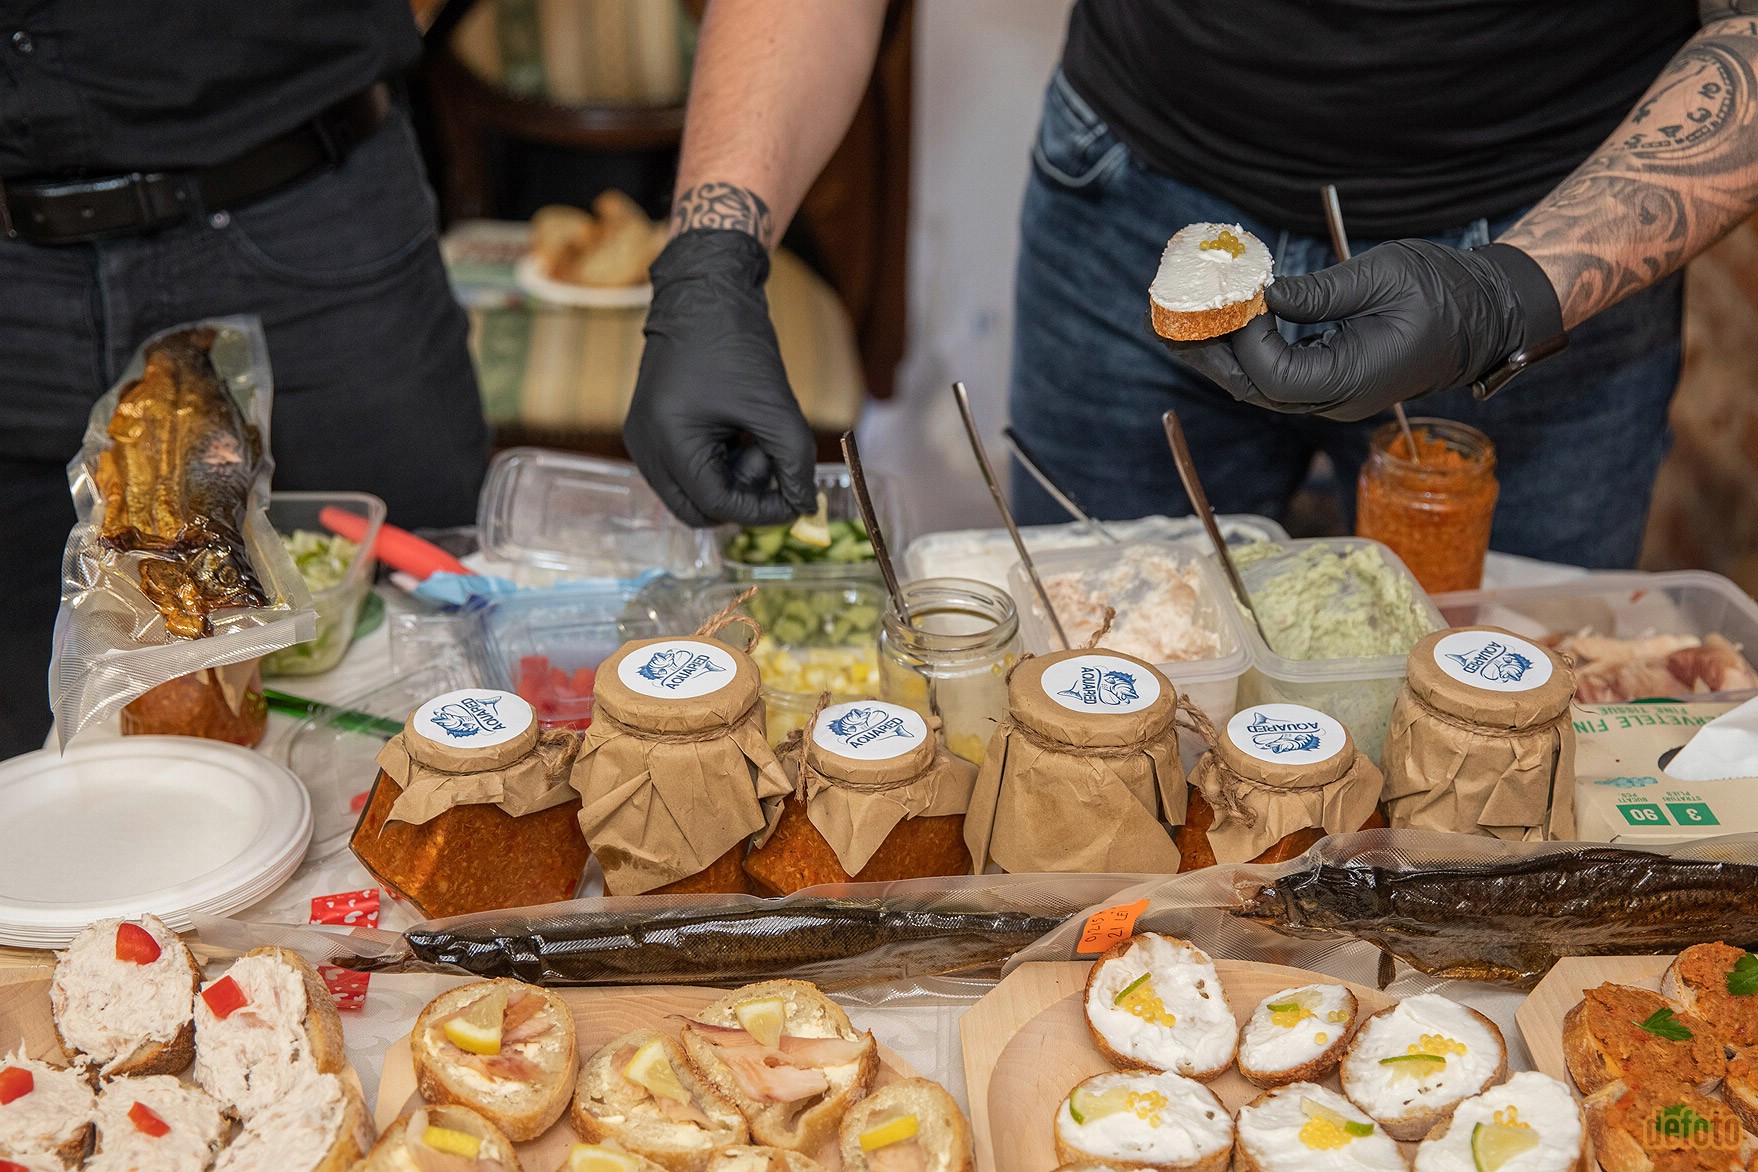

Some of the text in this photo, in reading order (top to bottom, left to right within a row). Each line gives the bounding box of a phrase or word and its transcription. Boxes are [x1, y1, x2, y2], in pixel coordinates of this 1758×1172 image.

[666, 654, 710, 690] AQUARED
[1463, 640, 1502, 674] AQUARED
[1081, 666, 1098, 705] AQUARED
[461, 698, 506, 730] AQUARED
[1600, 706, 1688, 716] FINE TISSUE
[849, 717, 904, 748] AQUARED
[1247, 722, 1319, 733] AQUARED
[1629, 809, 1659, 821] 90
[1686, 808, 1702, 821] 3
